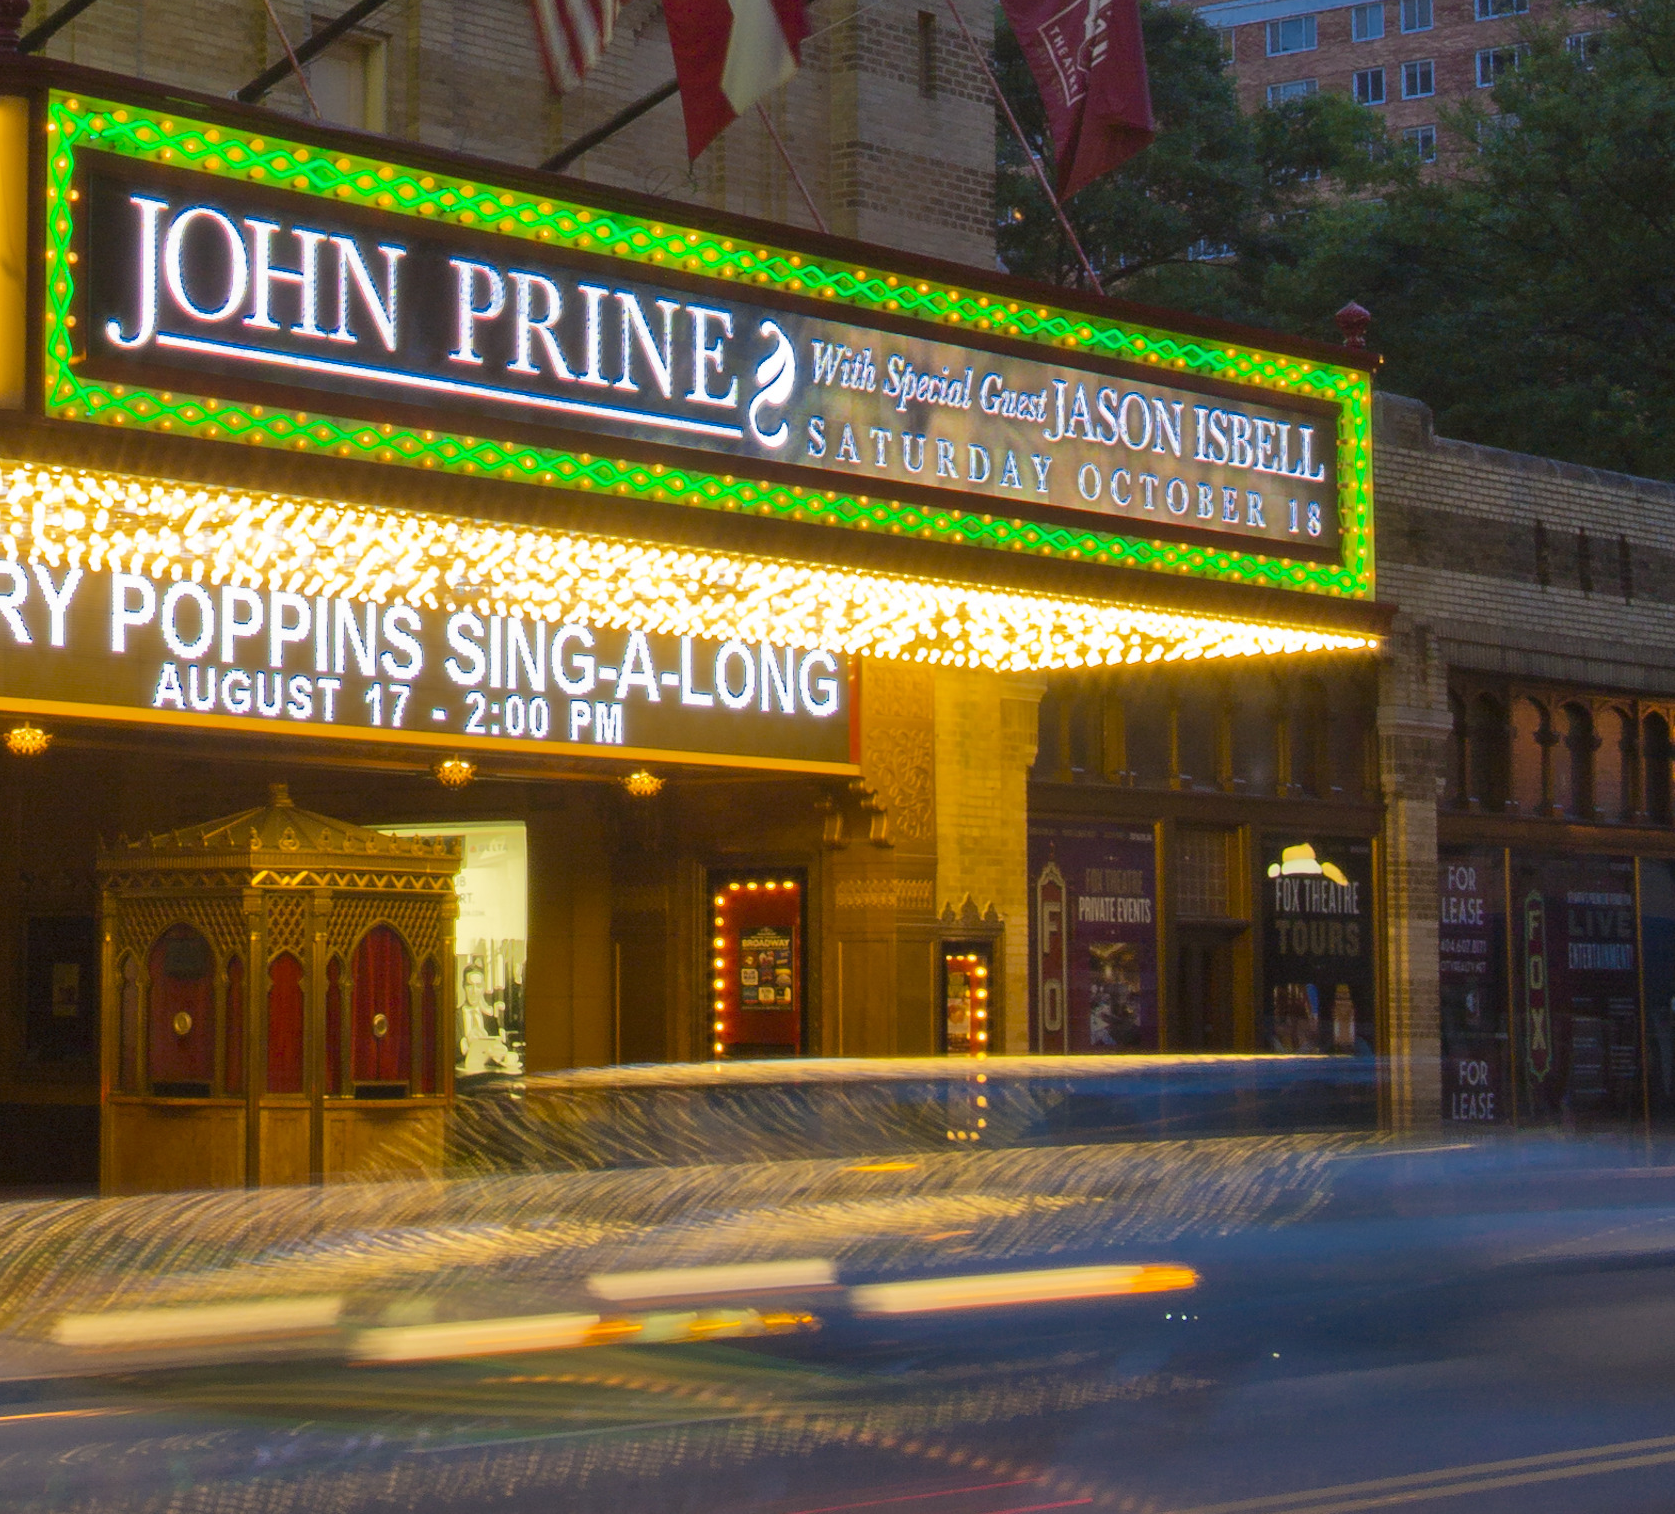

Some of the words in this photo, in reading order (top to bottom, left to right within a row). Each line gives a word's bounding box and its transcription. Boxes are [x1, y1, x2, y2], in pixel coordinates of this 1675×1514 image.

[106, 195, 406, 351] JOHN
[448, 257, 739, 408] PRINE
[810, 338, 877, 395] With
[882, 352, 973, 414] Special
[979, 372, 1047, 424] Guest
[1044, 378, 1184, 459] JASON
[1195, 405, 1324, 482] ISBELL
[807, 416, 1053, 495] SATURDAY
[1077, 461, 1268, 529] OCTOBER
[1288, 498, 1322, 538] 18
[111, 570, 425, 684] POPPINS
[445, 610, 842, 717] SING-A-LONG
[153, 662, 341, 724] AUGUST
[365, 679, 411, 729] 17
[465, 690, 550, 740] 2:00
[571, 698, 624, 745] PM
[1275, 878, 1300, 912] FOX
[1304, 879, 1360, 914] THEATRE
[1447, 865, 1477, 890] FOR
[1078, 896, 1115, 922] PRIVATE
[1117, 897, 1152, 924] EVENTS
[1441, 897, 1484, 925] LEASE
[1567, 908, 1632, 938] LIVE
[741, 939, 790, 948] BROADWAY
[1275, 919, 1360, 957] TOURS
[1042, 900, 1062, 1032] FO
[1528, 909, 1547, 1051] FOX
[1458, 1060, 1488, 1086] FOR
[1451, 1092, 1495, 1120] LEASE
